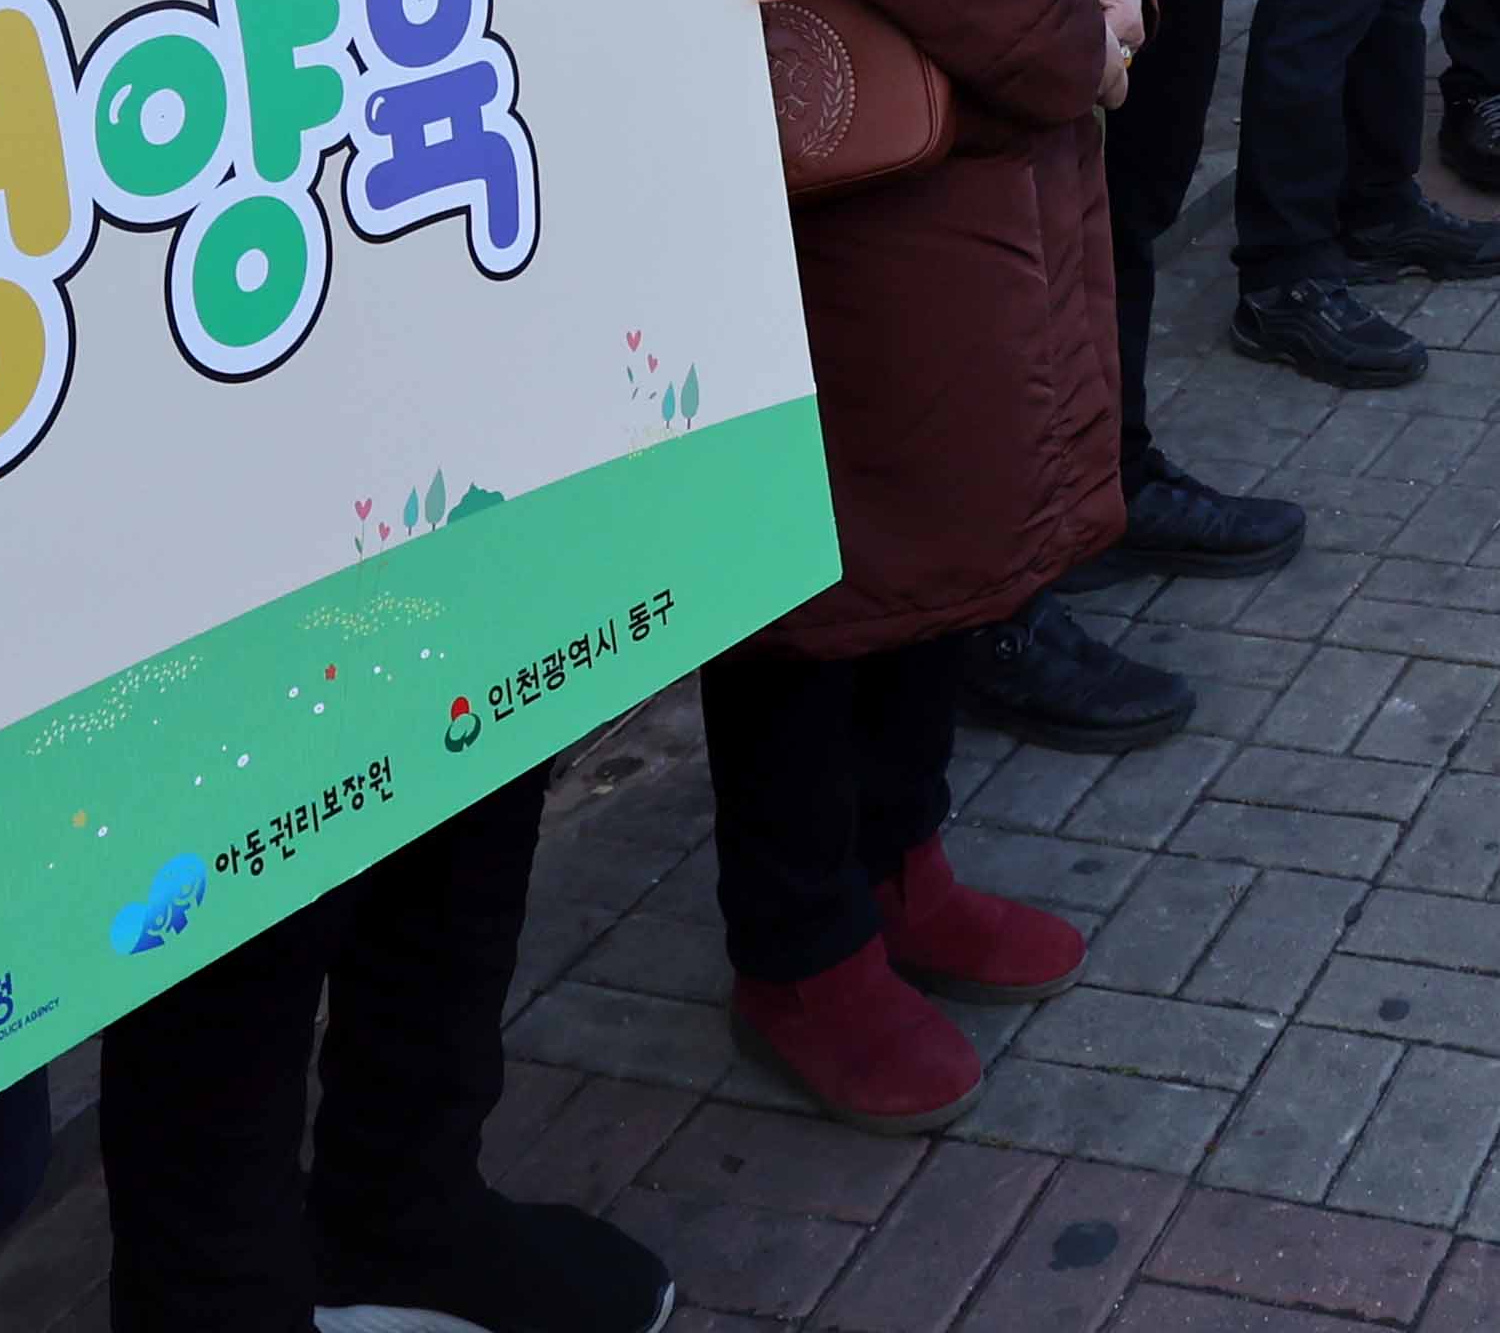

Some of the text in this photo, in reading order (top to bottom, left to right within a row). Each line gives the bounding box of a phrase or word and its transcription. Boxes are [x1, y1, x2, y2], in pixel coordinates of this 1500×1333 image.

[487, 588, 675, 723] 인천광역시 동구
[215, 755, 394, 877] 아동권리보장원
